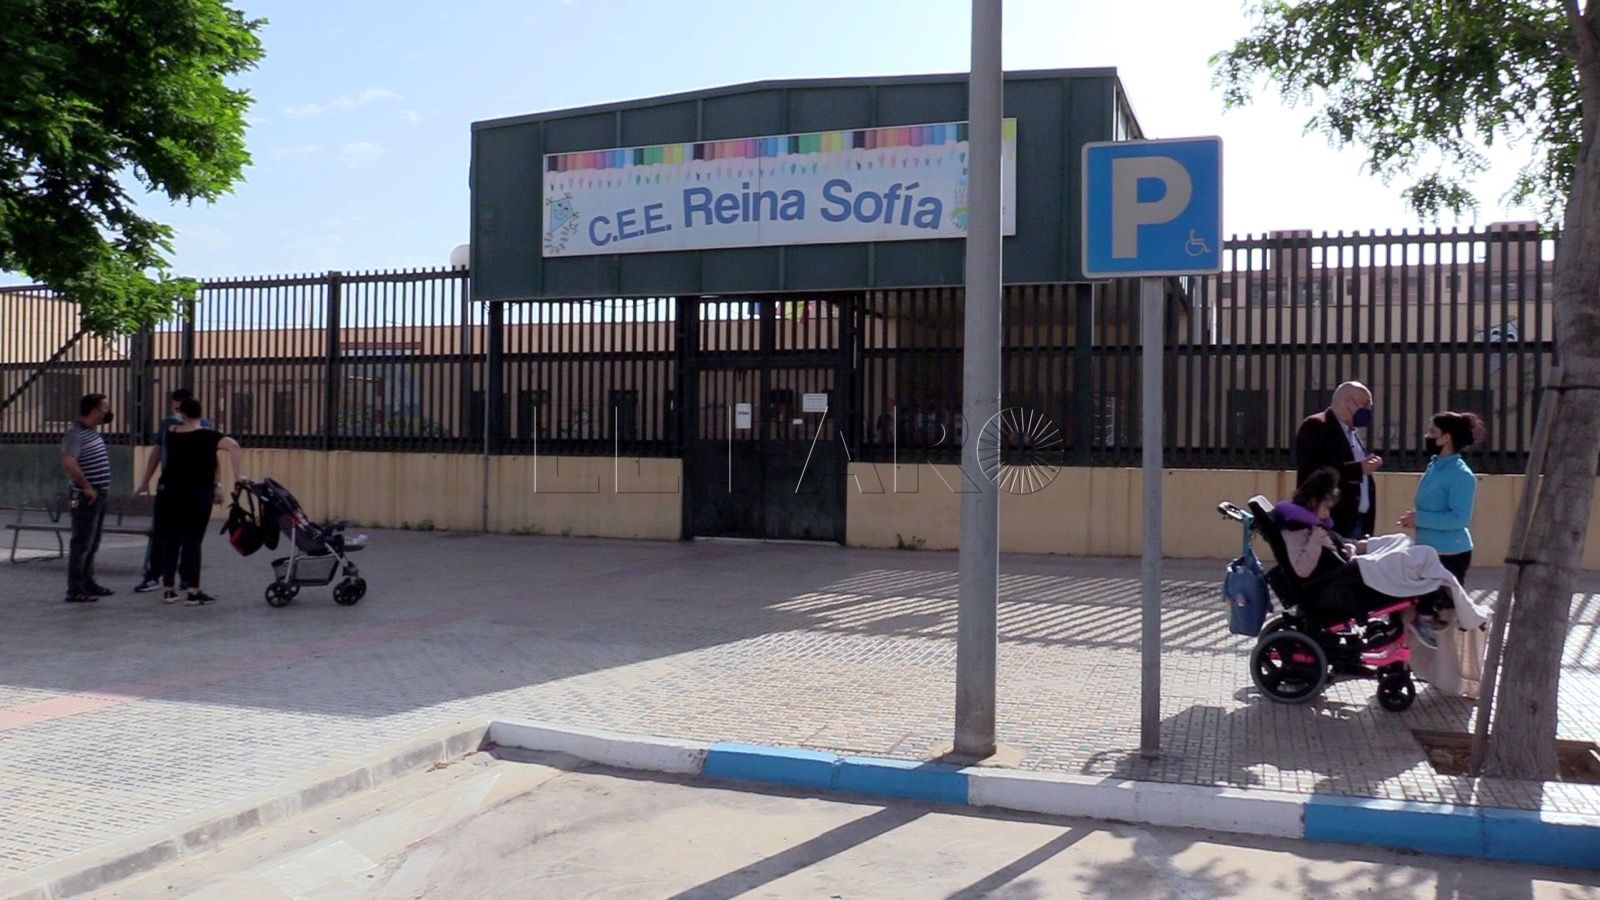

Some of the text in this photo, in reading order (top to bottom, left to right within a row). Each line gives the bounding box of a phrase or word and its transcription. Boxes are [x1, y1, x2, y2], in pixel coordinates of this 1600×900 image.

[589, 178, 943, 247] C.E.E. Reina Sofía
[1112, 156, 1192, 259] P
